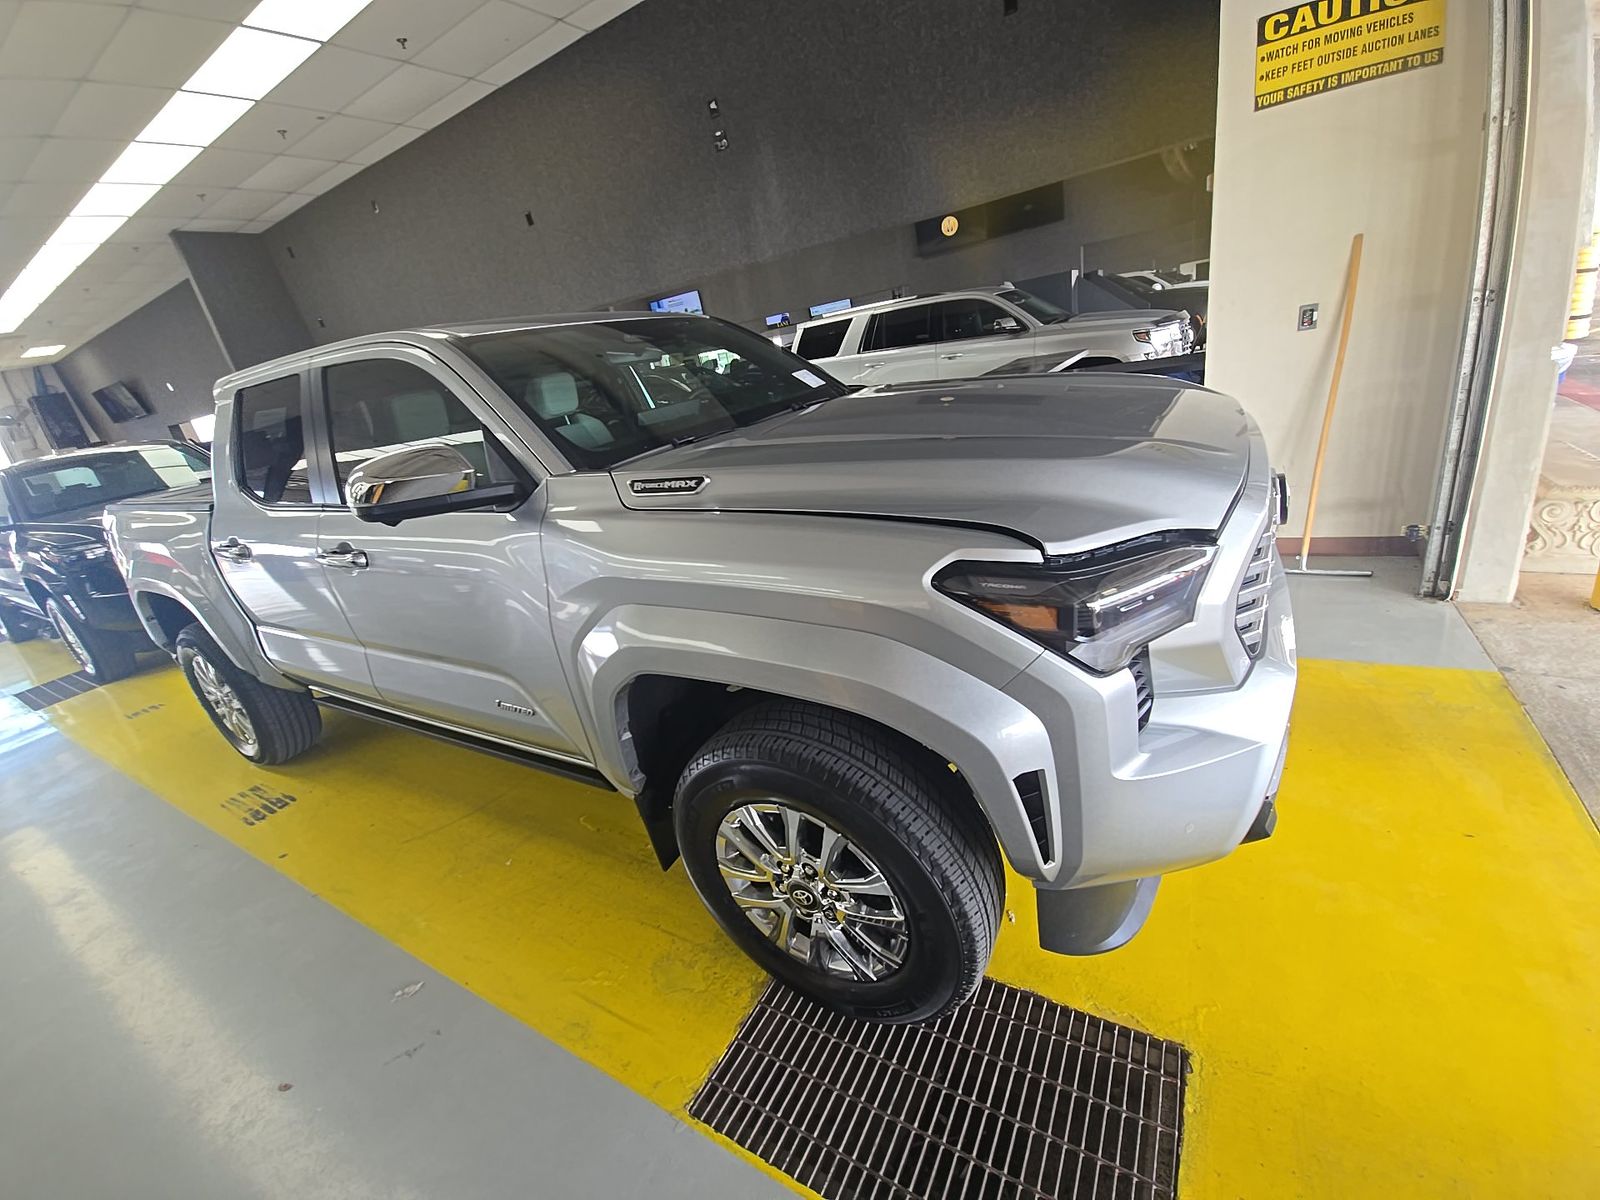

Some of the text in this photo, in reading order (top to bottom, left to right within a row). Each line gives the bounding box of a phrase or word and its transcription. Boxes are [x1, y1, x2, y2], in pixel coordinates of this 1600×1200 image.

[1264, 0, 1408, 41] CAUTI
[1266, 12, 1414, 62] WATCH FOR MOVING VEHICLES
[1257, 50, 1440, 108] YOUR SAFETY IS IMPORTANT TO US
[1264, 25, 1440, 82] KEEP FEET OUTSIDE AUCTION LANES
